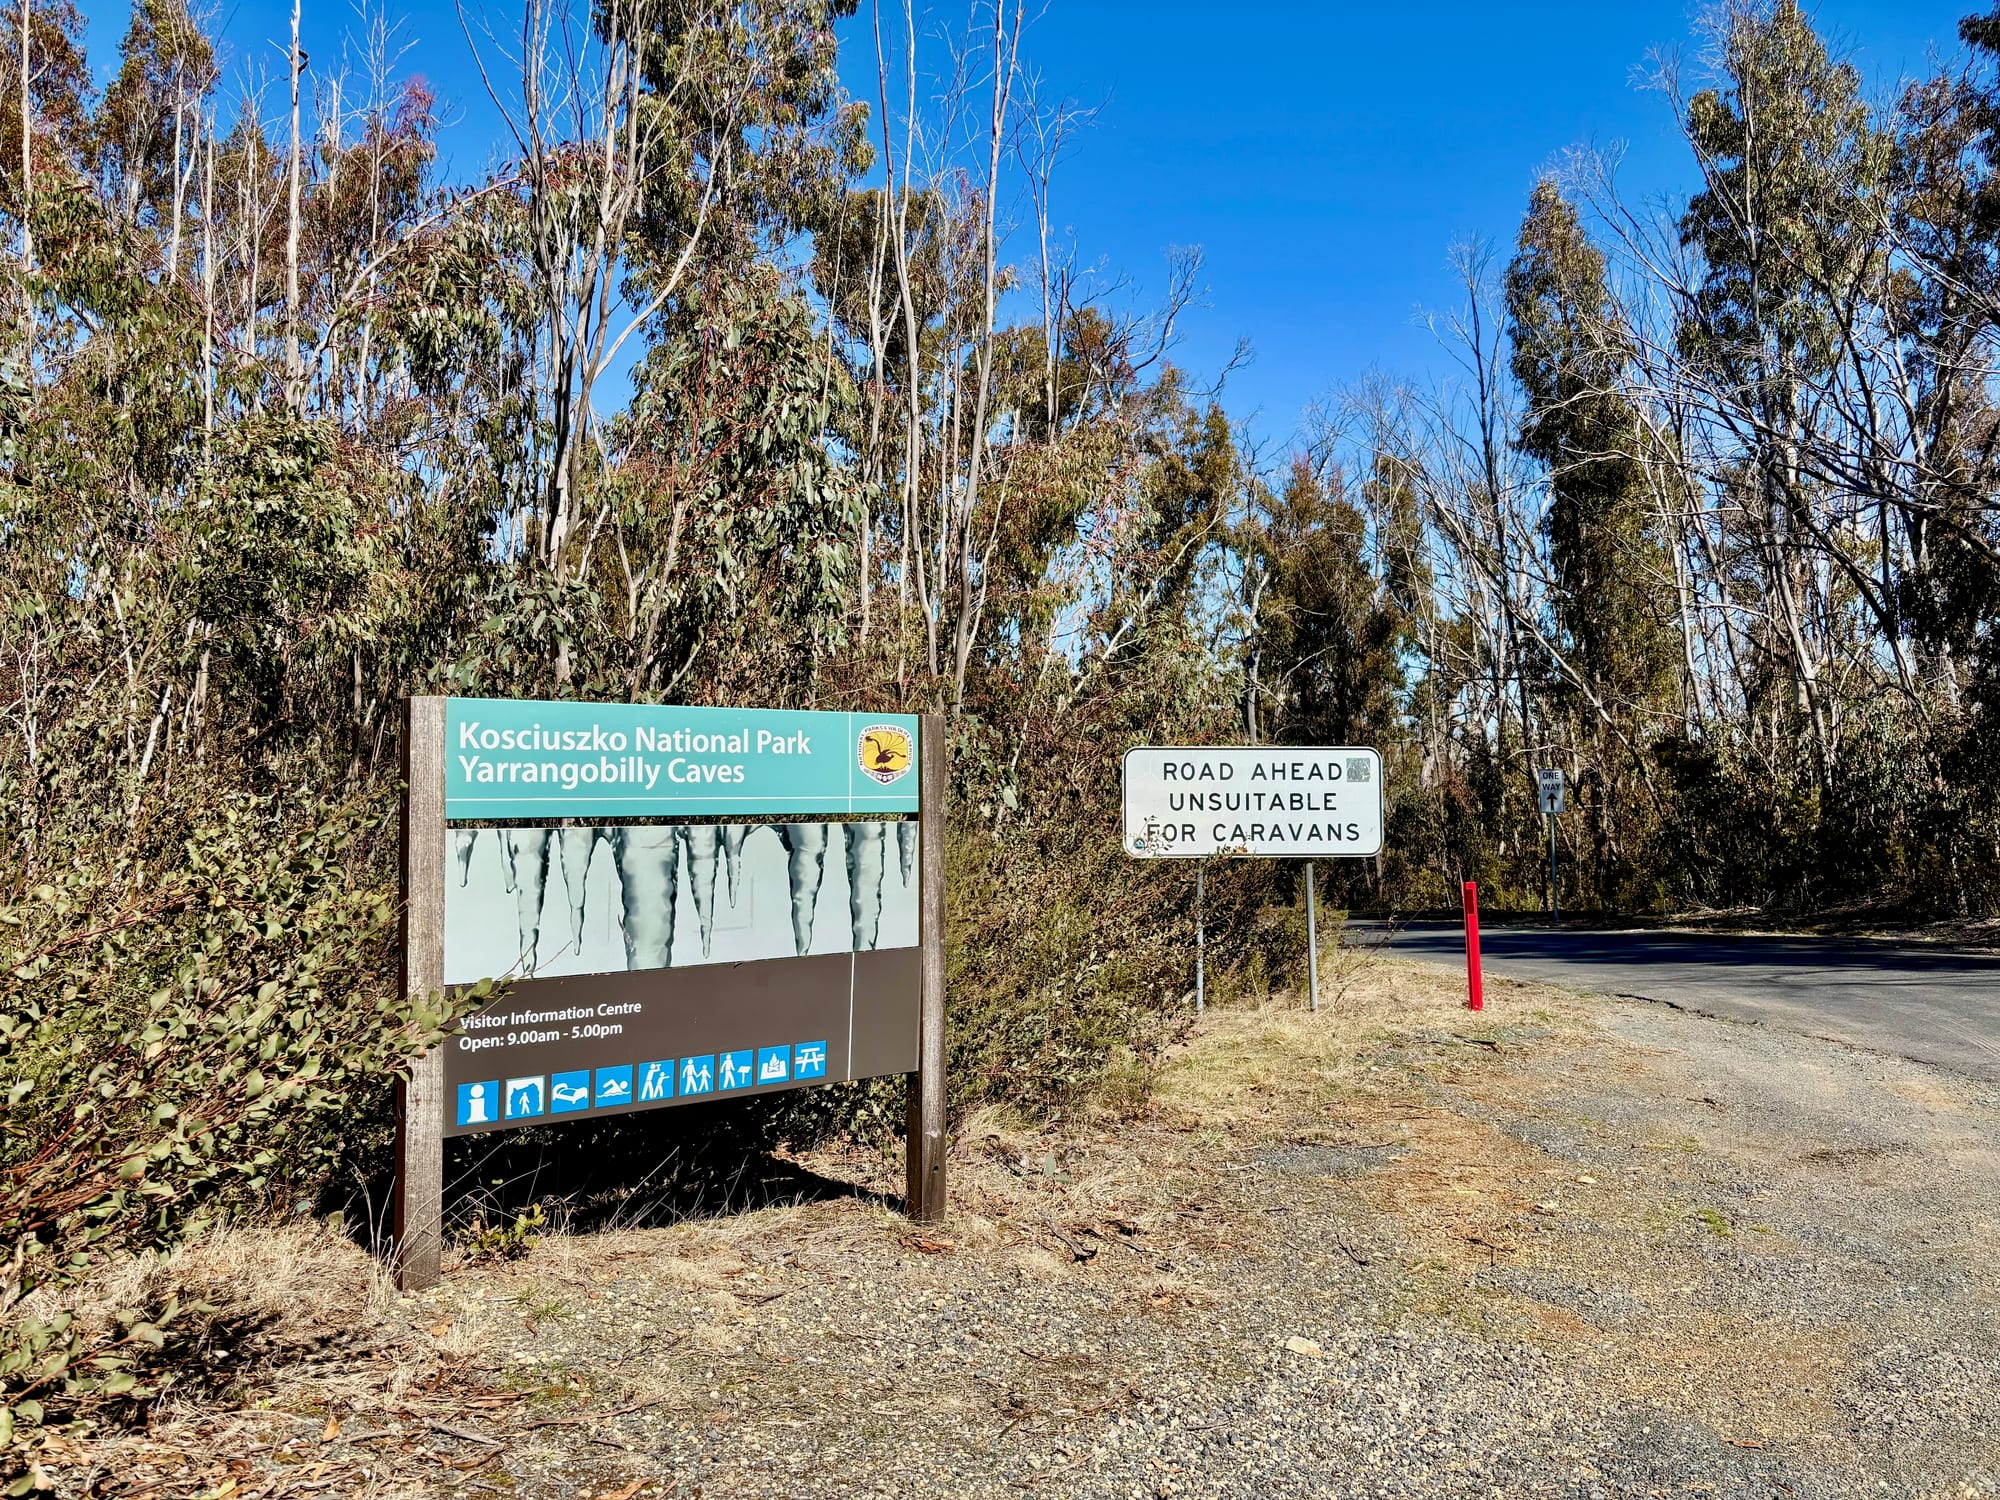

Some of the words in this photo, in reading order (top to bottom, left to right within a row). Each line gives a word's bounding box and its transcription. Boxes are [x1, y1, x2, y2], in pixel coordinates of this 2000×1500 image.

[459, 722, 627, 752] Kosciuszko
[636, 726, 749, 754] National
[757, 729, 811, 755] Park
[459, 755, 661, 790] Yarrangobilly
[667, 758, 745, 784] Caves
[1163, 762, 1234, 781] ROAD
[1251, 762, 1343, 781] AHEAD
[1542, 772, 1560, 780] ONE
[1542, 783, 1561, 791] WAY
[1169, 793, 1338, 811] UNSUITABLE
[1147, 823, 1196, 842] FOR
[1213, 823, 1361, 842] CARAVANS
[460, 1013, 508, 1030] Visitor
[511, 1006, 594, 1025] Information
[597, 1001, 642, 1016] Centre
[459, 1036, 505, 1053] Open:
[507, 1029, 560, 1046] 9.00am
[571, 1023, 623, 1040] 5.00pm
